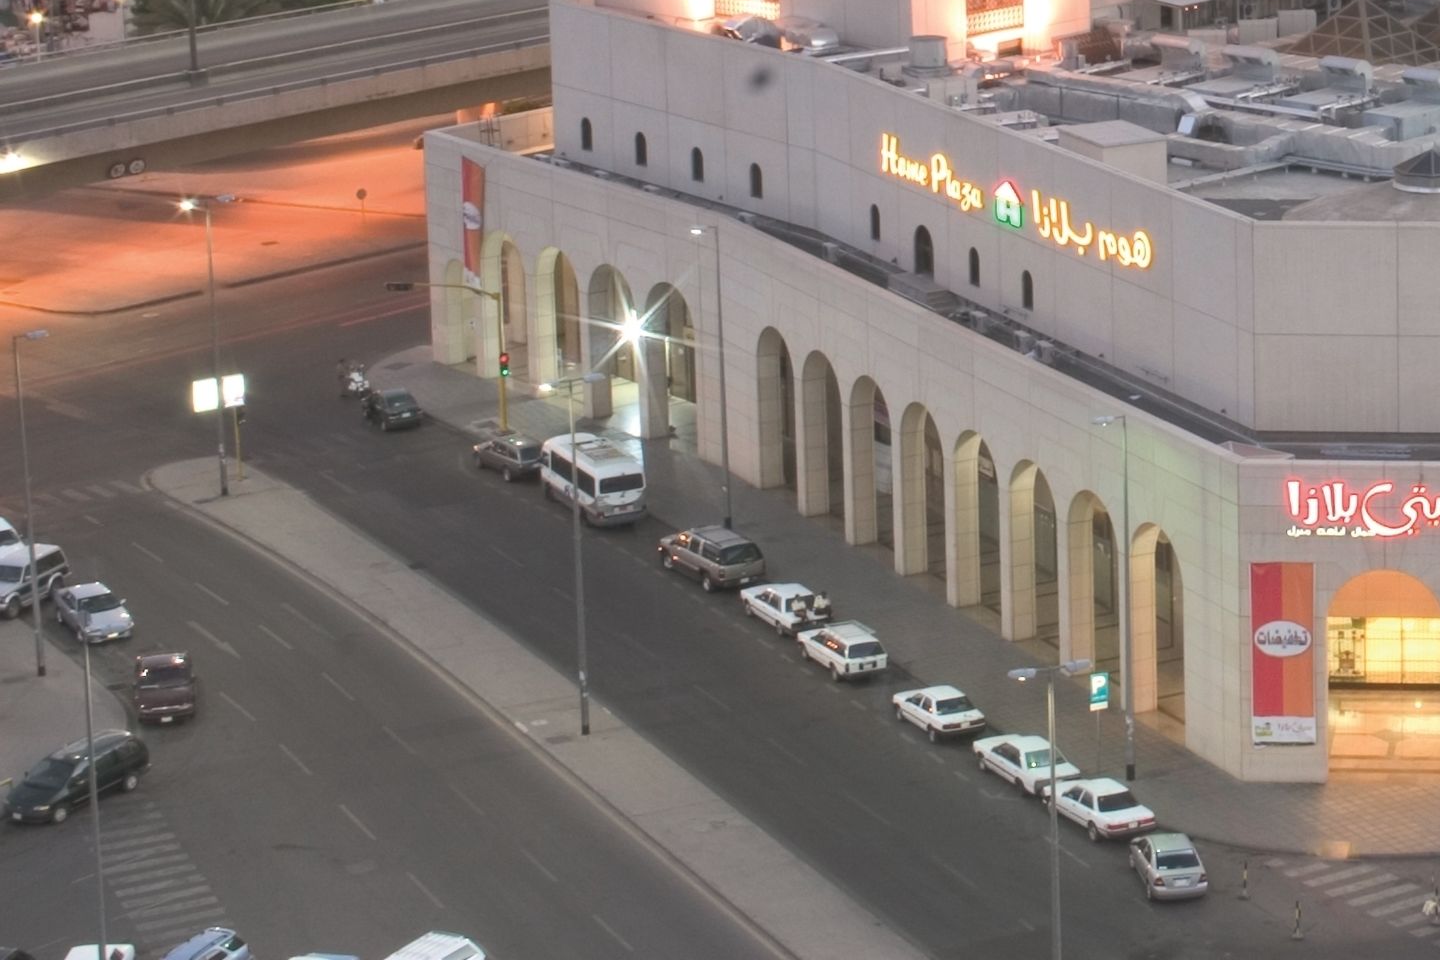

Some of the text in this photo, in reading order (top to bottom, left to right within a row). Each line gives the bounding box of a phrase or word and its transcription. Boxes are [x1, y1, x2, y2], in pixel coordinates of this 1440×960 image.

[881, 132, 984, 212] Home Plaza
[1031, 188, 1152, 269] هوم بلازا
[1286, 480, 1359, 526] بلازا
[1091, 675, 1107, 695] P
